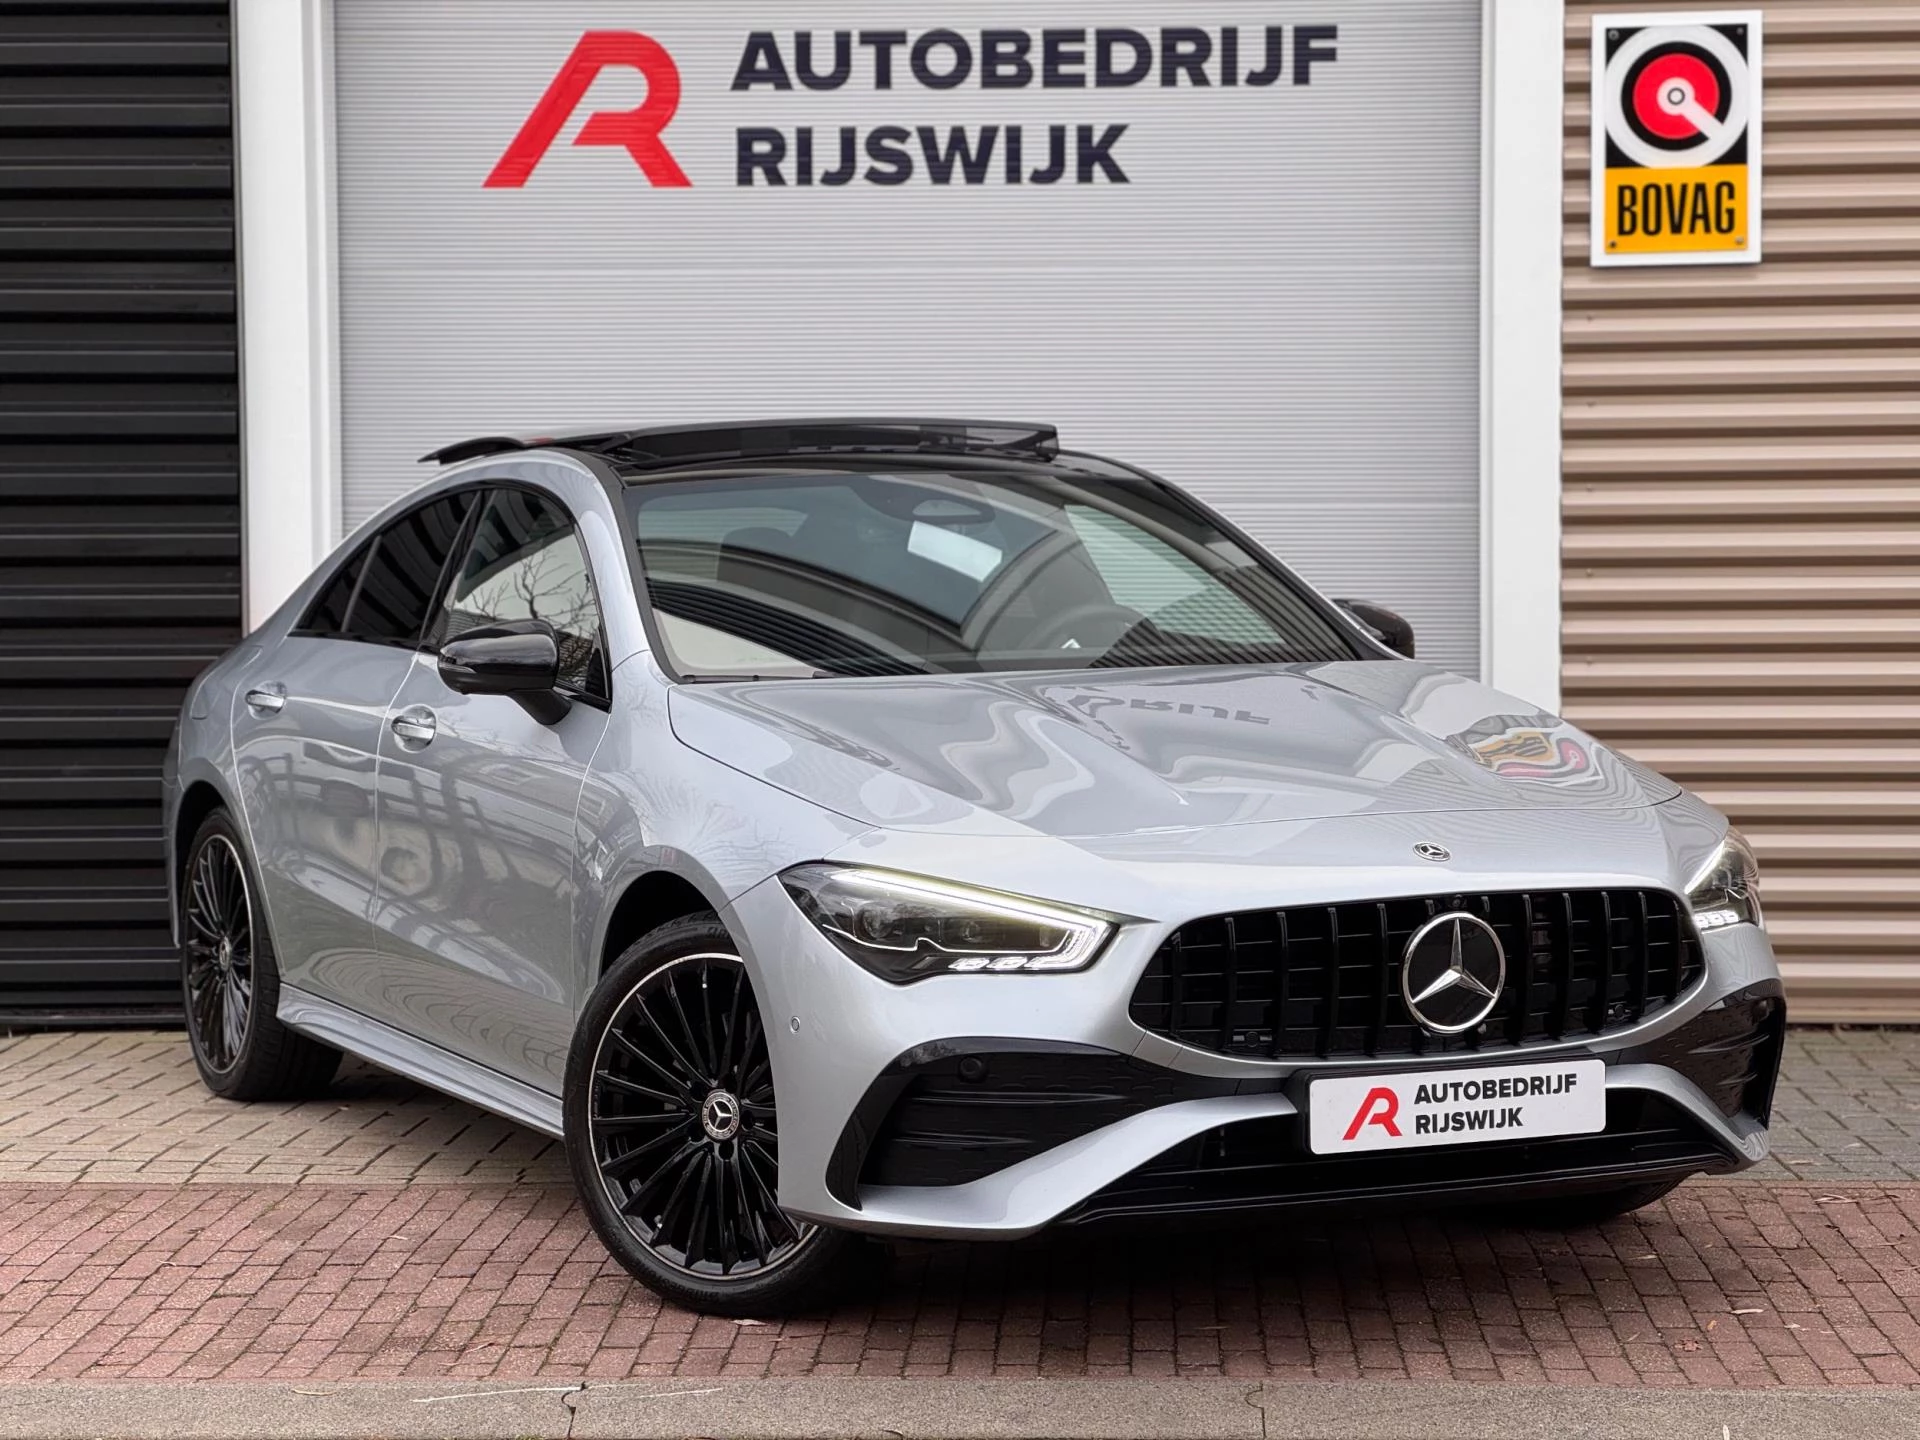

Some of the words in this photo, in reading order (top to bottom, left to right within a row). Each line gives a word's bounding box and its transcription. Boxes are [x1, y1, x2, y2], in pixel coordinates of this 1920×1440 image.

[729, 25, 1338, 92] AUTOBEDRIJF
[735, 123, 1131, 187] RIJSWIJK
[1617, 181, 1736, 237] BOVAG
[1413, 1073, 1578, 1105] AUTOBEDRIJF
[1414, 1107, 1524, 1135] RIJSWIJK
